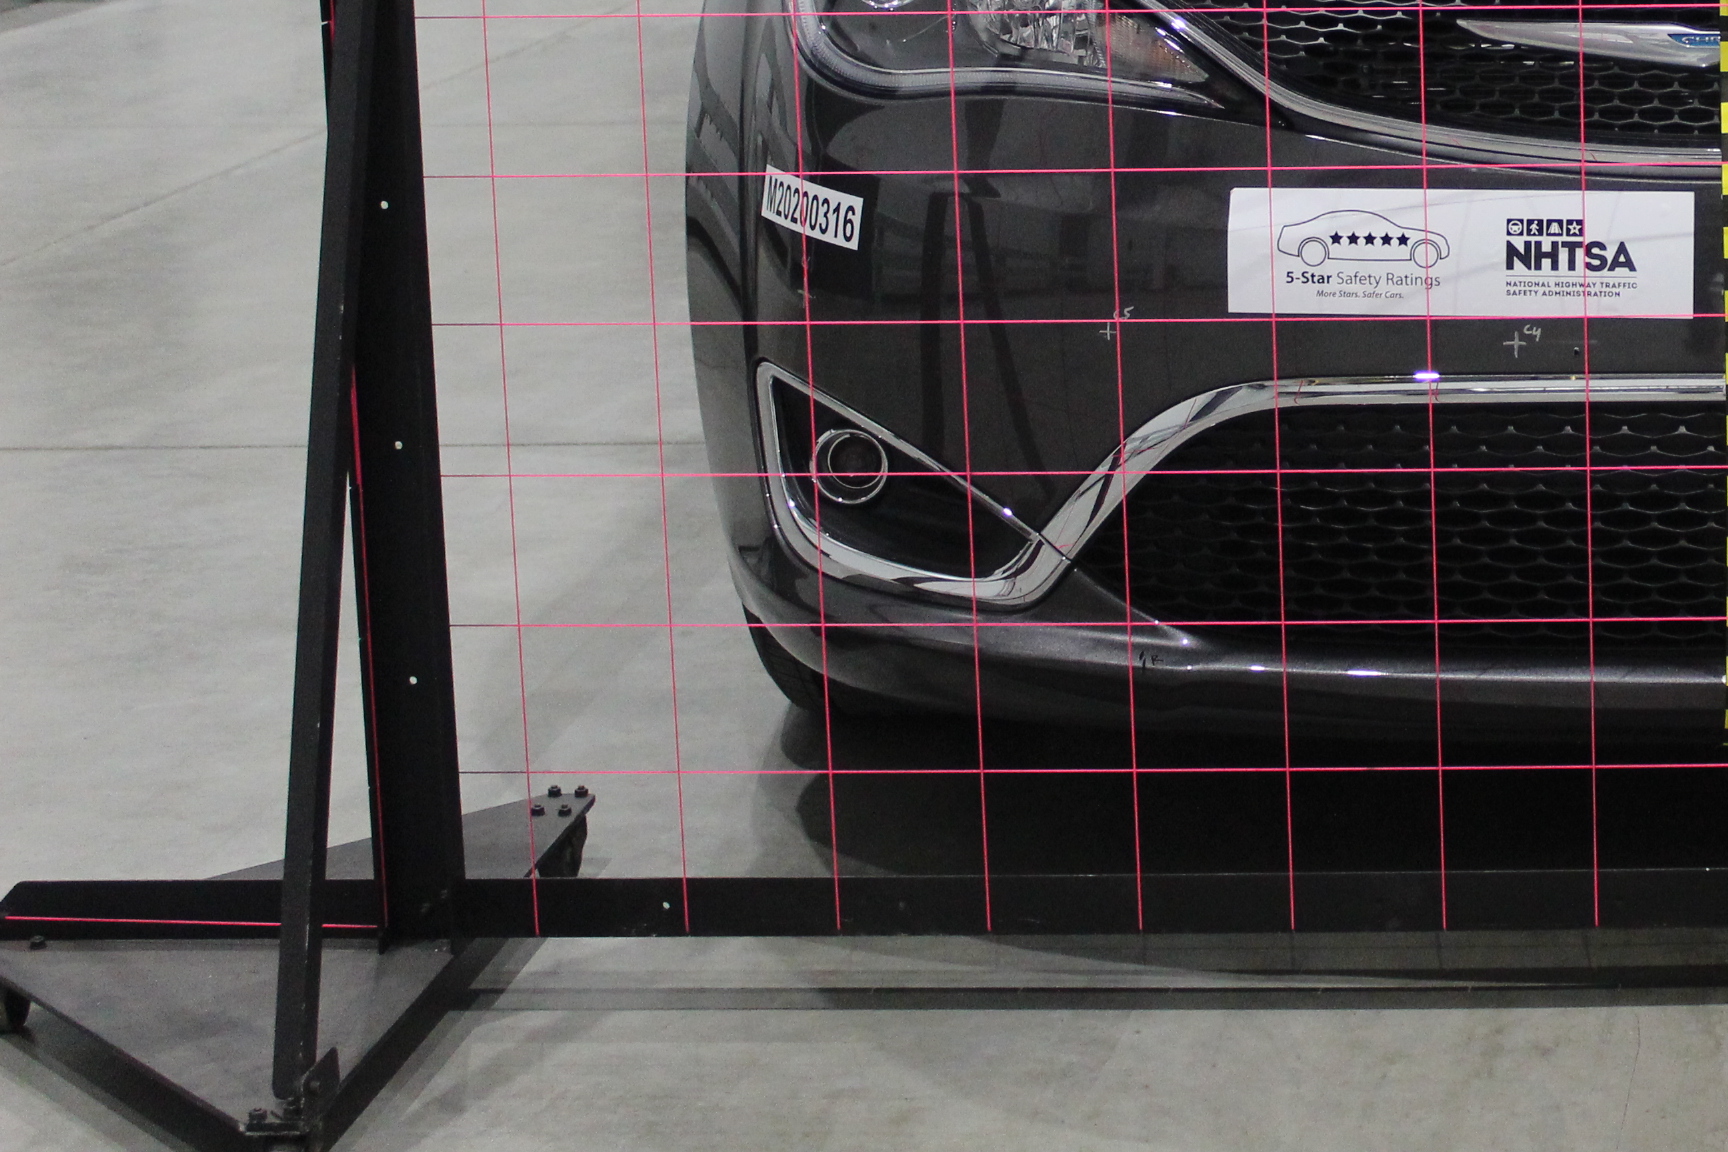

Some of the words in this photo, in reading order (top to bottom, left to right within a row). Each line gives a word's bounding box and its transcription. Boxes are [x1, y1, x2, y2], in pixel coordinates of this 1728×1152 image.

[767, 175, 856, 242] M20200316
[1506, 240, 1637, 272] NHTSA
[1285, 271, 1332, 285] 5-Star
[1336, 271, 1382, 288] Safety
[1386, 272, 1441, 290] Ratings
[1316, 290, 1337, 298] More
[1338, 290, 1361, 298] Stars.
[1362, 290, 1384, 298] Safer
[1385, 291, 1405, 299] Cars.
